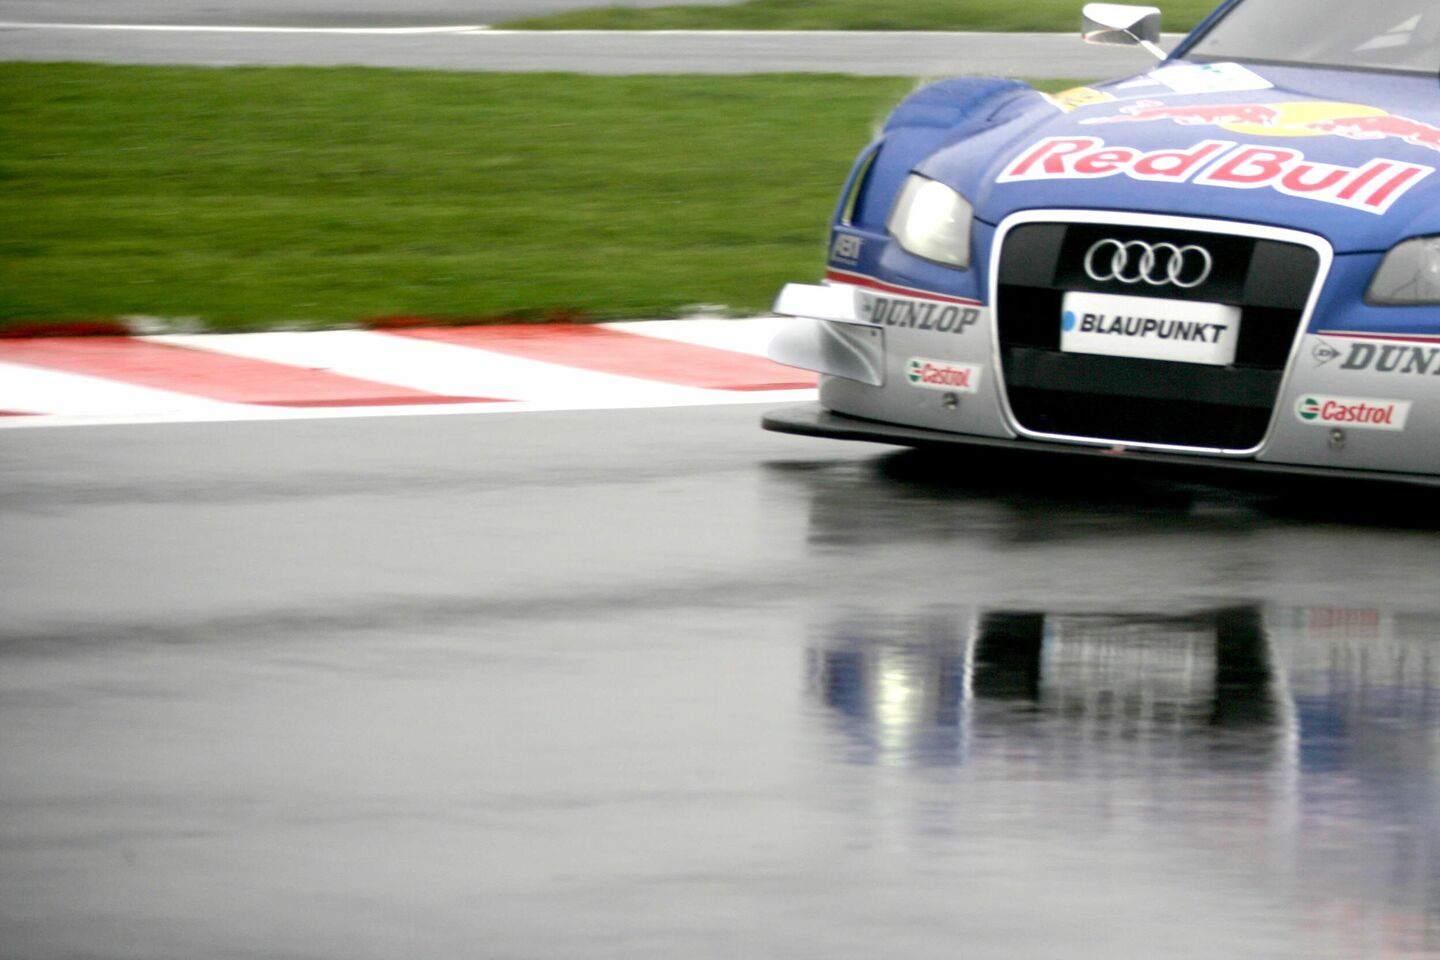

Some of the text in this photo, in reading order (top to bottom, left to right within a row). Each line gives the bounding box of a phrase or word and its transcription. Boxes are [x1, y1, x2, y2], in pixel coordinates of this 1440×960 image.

[1000, 136, 1430, 212] Red Bull
[871, 297, 981, 335] DUNLOP
[1079, 313, 1229, 345] BLAUPUNKT
[920, 362, 972, 389] Castrol
[1320, 399, 1394, 427] Castrol
